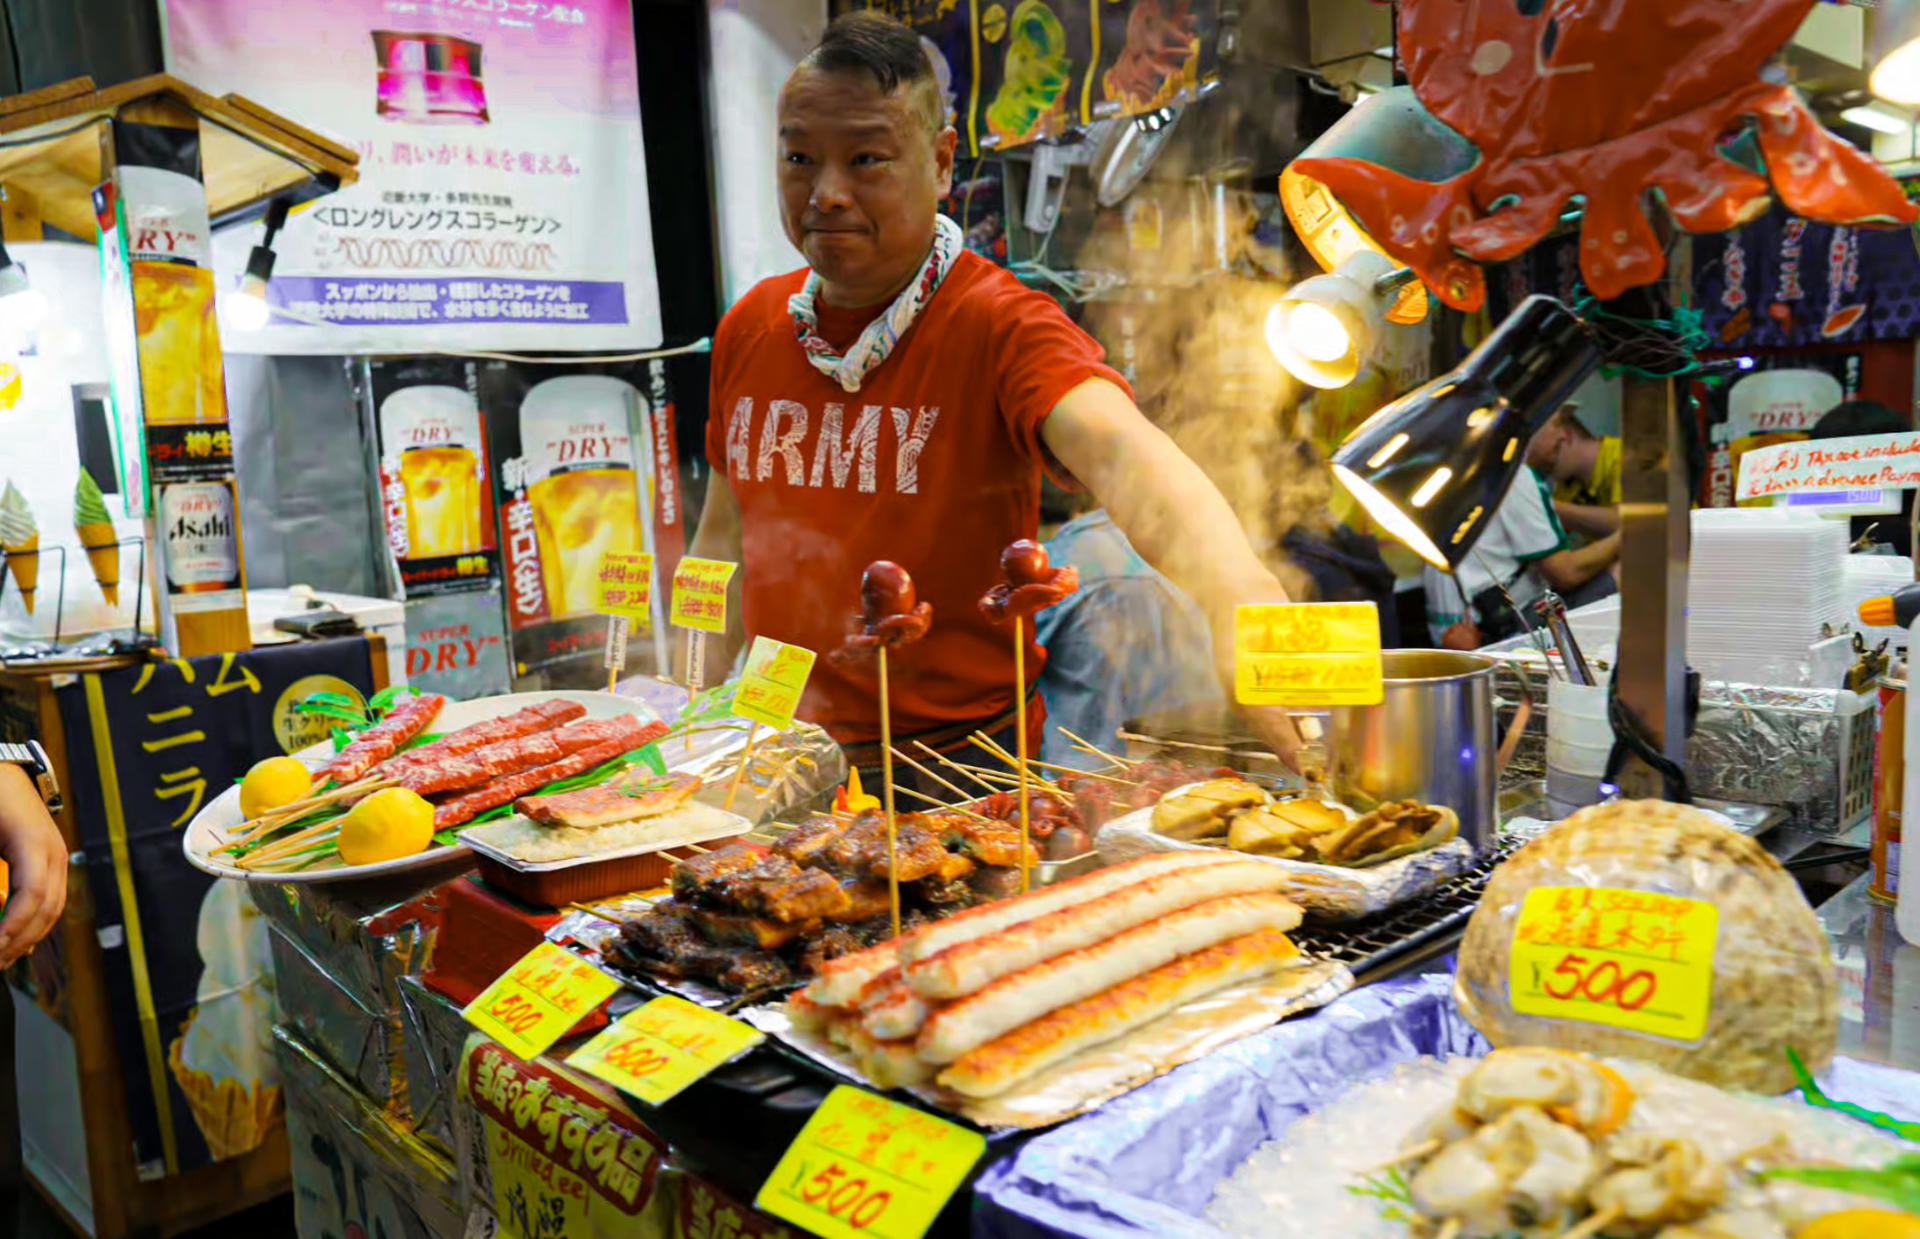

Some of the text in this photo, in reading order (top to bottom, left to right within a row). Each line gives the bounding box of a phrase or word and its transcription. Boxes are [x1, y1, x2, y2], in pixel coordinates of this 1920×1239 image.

[411, 426, 452, 442] DRY
[726, 396, 941, 495] ARMY
[556, 436, 616, 463] DRY
[169, 512, 231, 541] Asahi
[417, 624, 471, 641] SUPER
[405, 640, 484, 677] DRY
